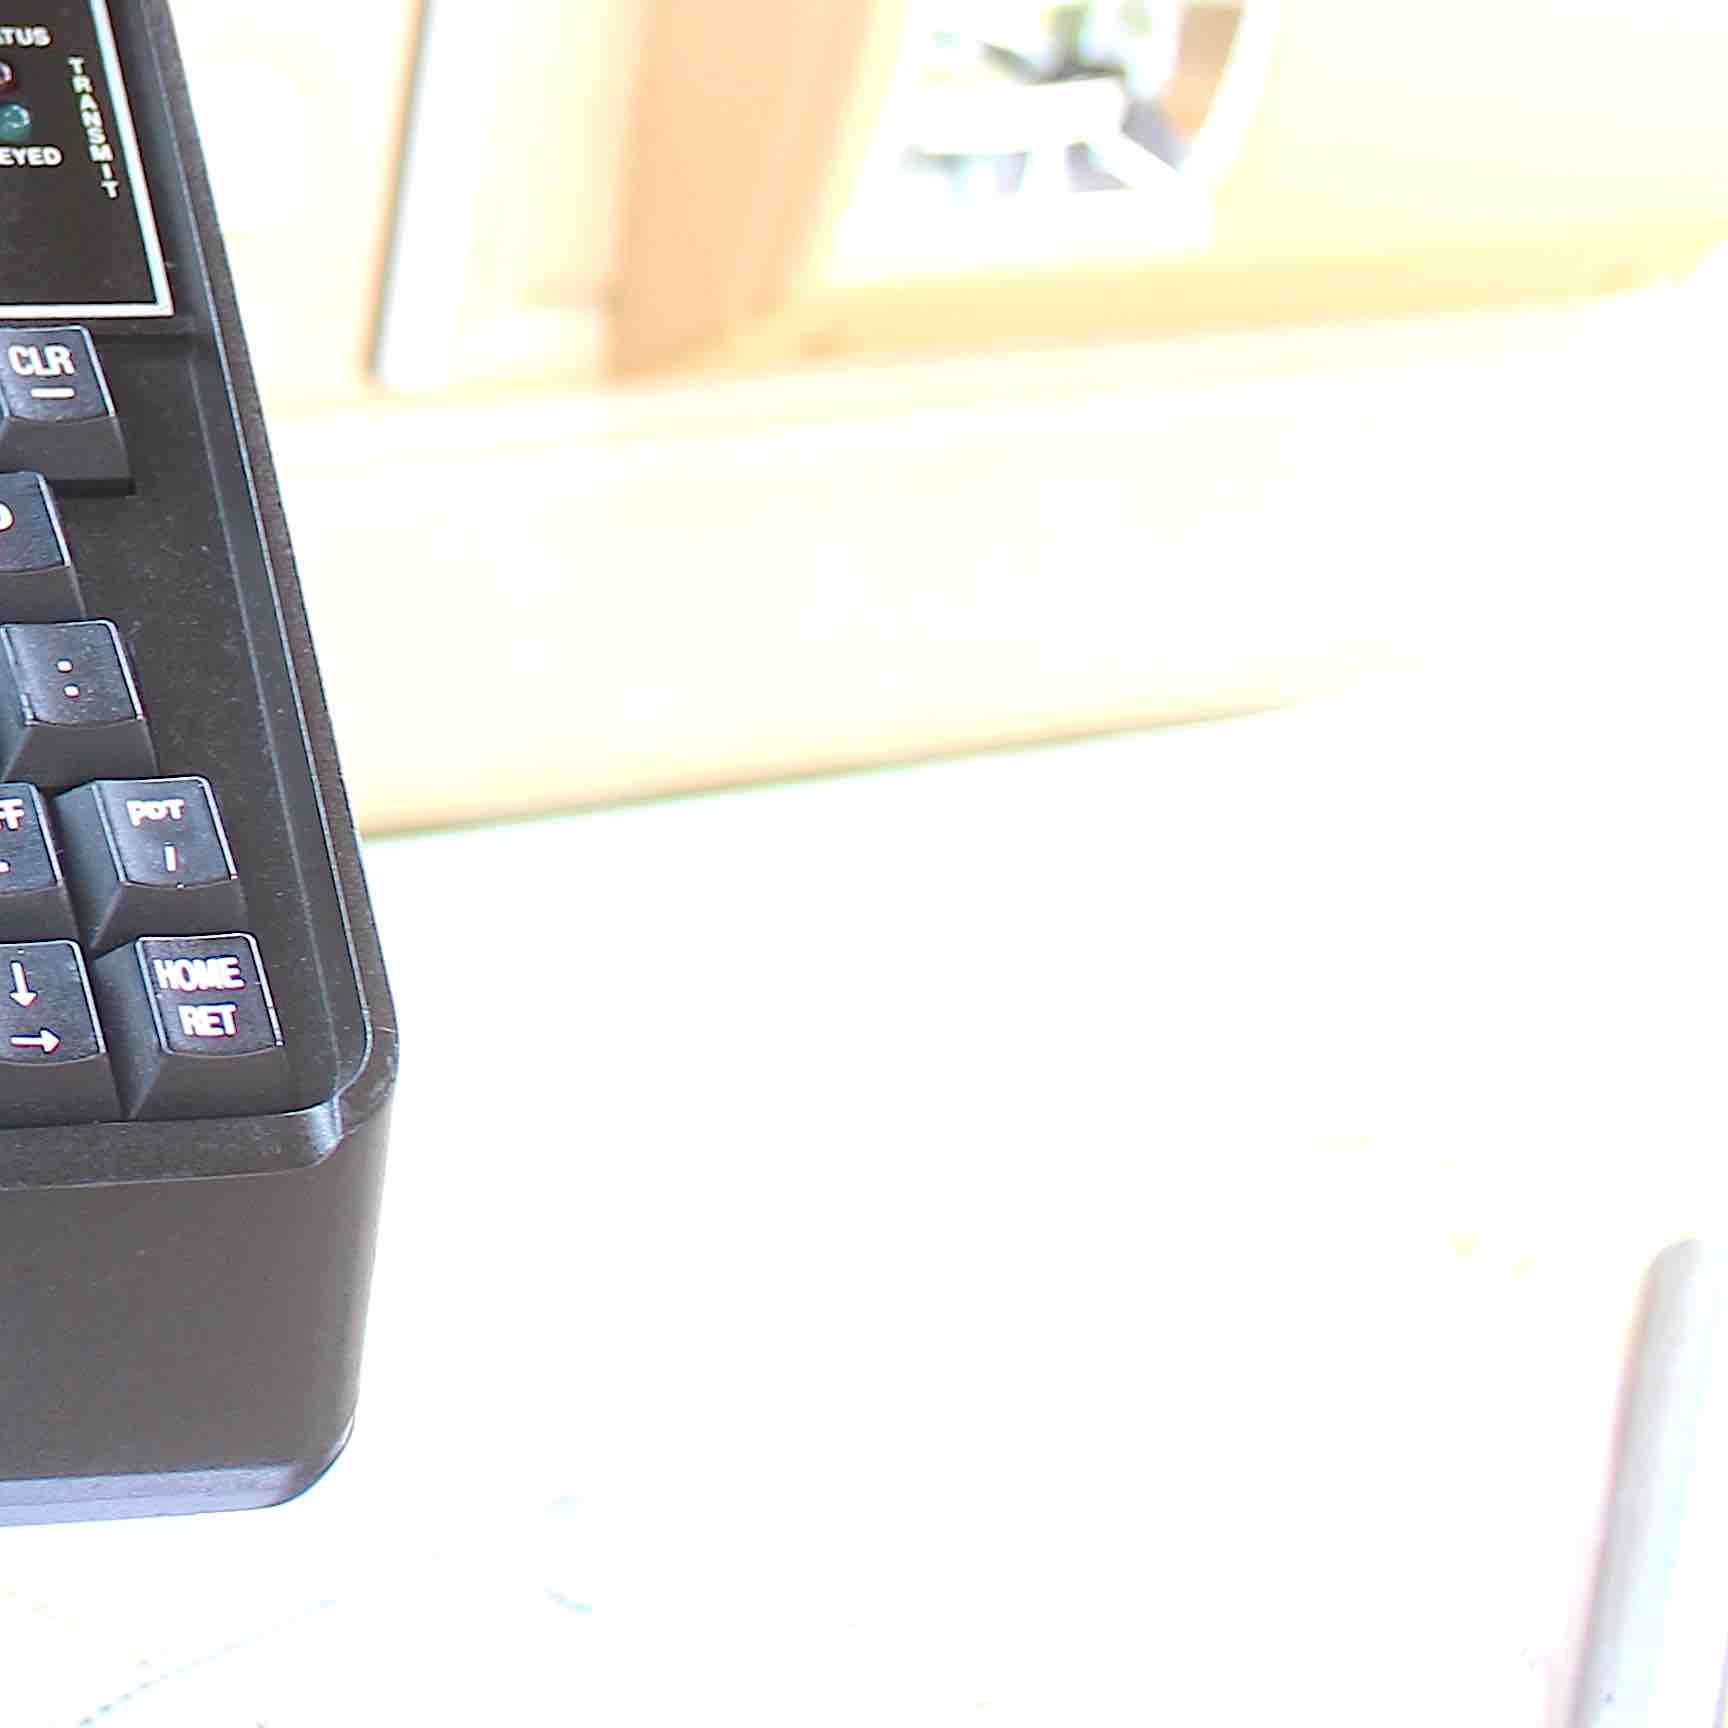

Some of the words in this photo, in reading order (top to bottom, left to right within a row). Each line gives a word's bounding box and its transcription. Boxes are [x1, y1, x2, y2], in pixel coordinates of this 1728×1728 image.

[67, 56, 121, 200] TRANSMIT
[6, 344, 76, 378] CLR
[152, 956, 246, 992] HOME
[177, 1002, 239, 1037] RET
